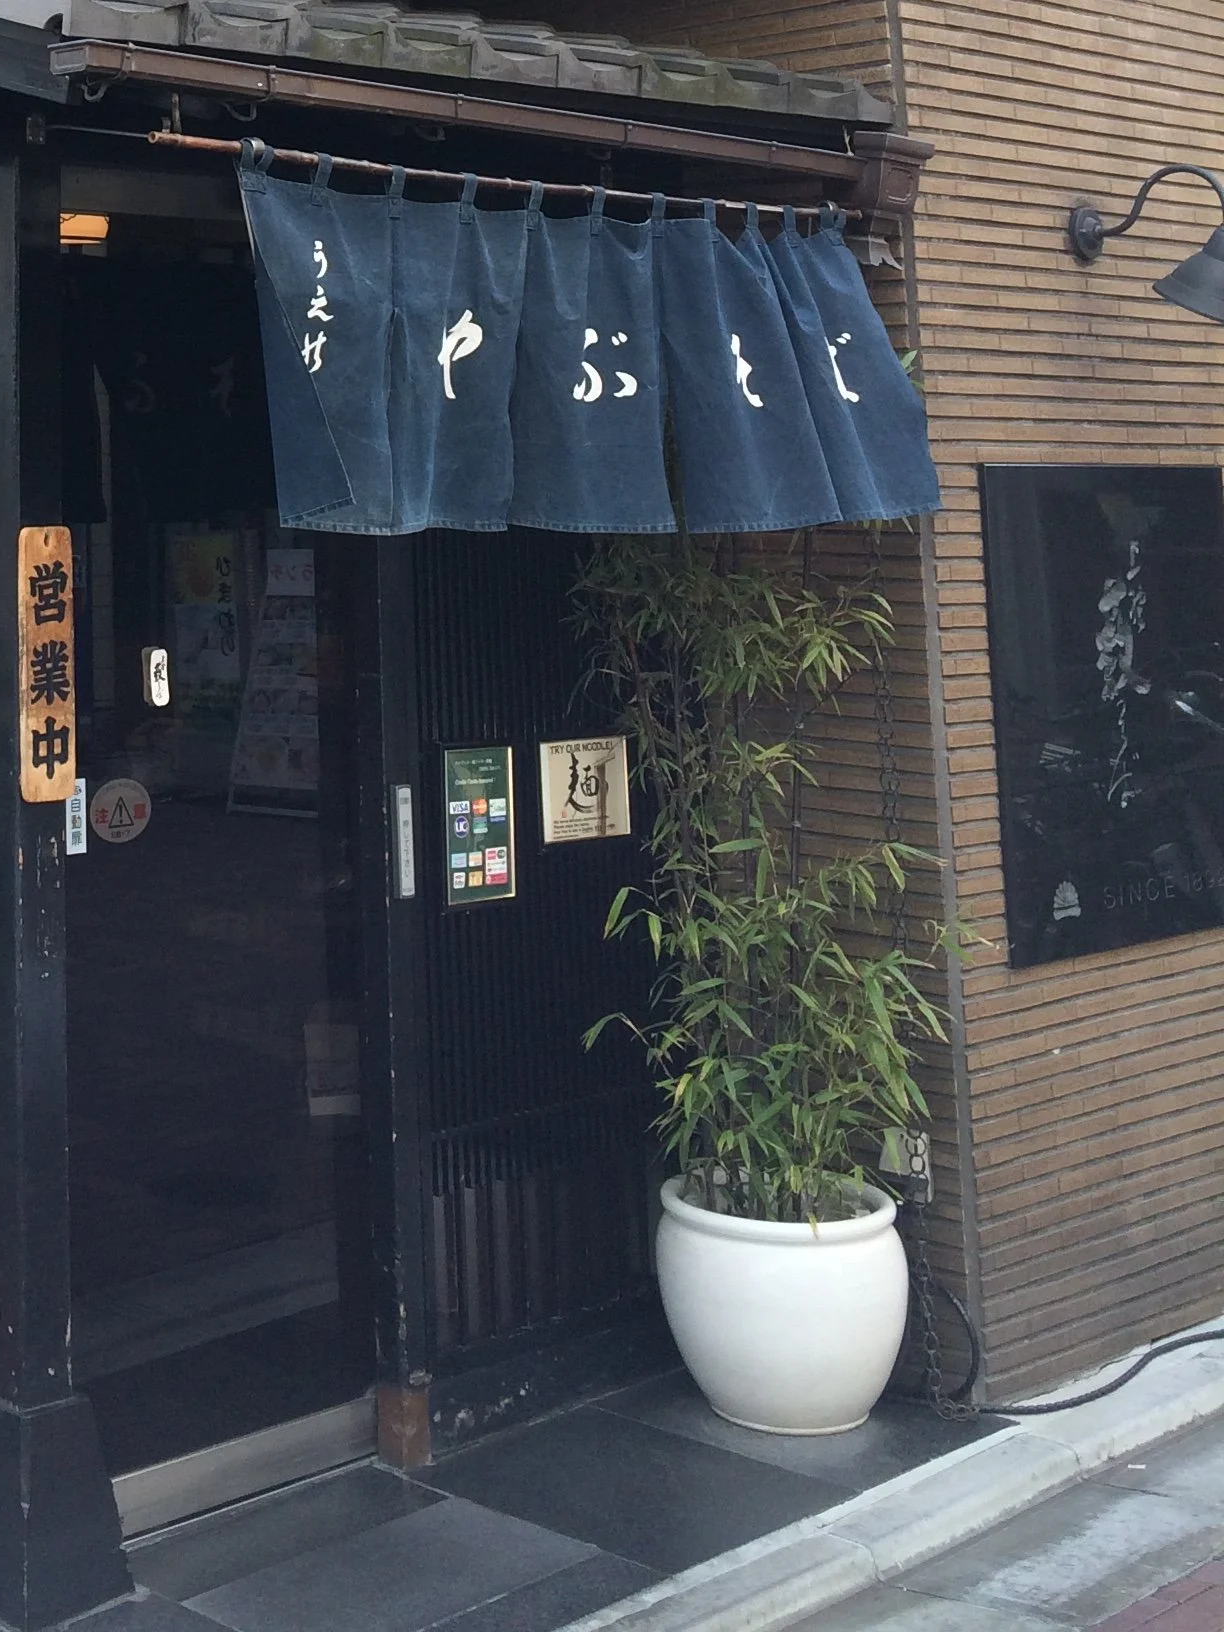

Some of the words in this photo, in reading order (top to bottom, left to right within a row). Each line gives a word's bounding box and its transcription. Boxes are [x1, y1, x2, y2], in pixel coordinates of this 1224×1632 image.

[29, 561, 71, 780] 営業中
[550, 745, 565, 755] TRY
[565, 743, 581, 753] OUR
[451, 802, 469, 813] VISA
[1103, 874, 1176, 909] SINCE
